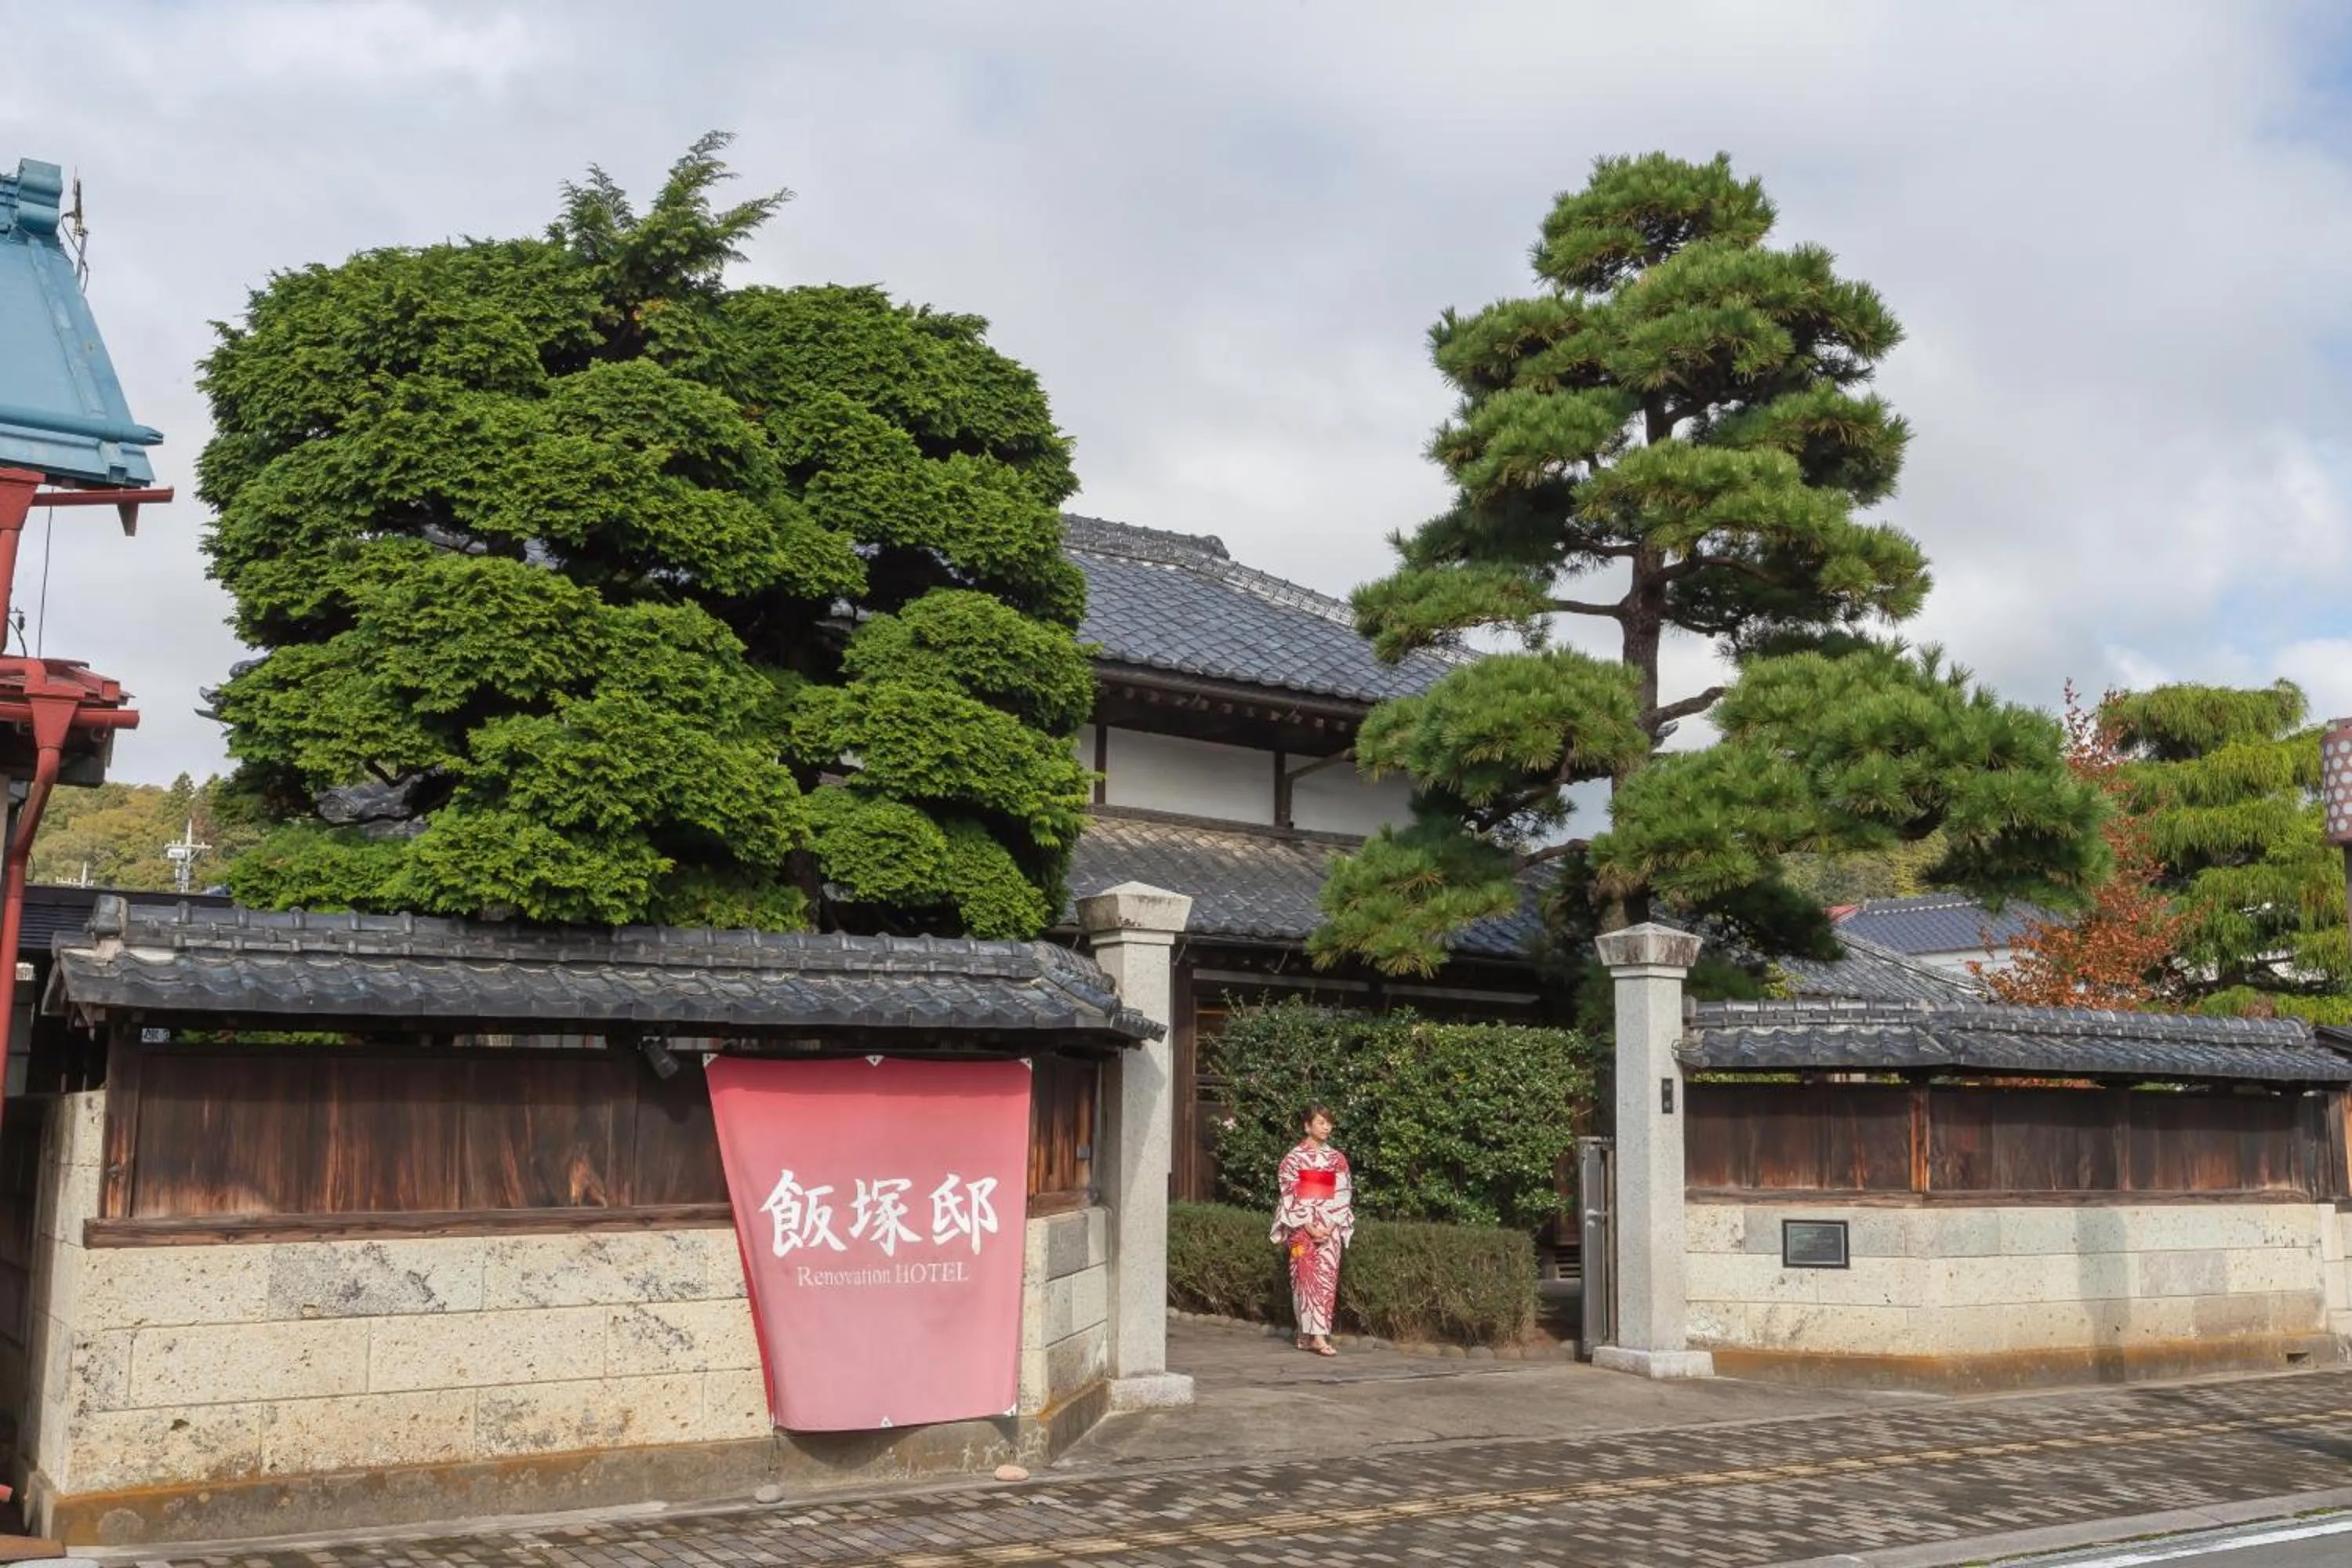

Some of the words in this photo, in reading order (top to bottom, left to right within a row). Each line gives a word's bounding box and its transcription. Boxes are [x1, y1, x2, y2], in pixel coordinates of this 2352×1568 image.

[759, 1169, 998, 1257] 飯塚邸
[797, 1266, 891, 1287] Renovation
[895, 1261, 968, 1283] HOTEL
